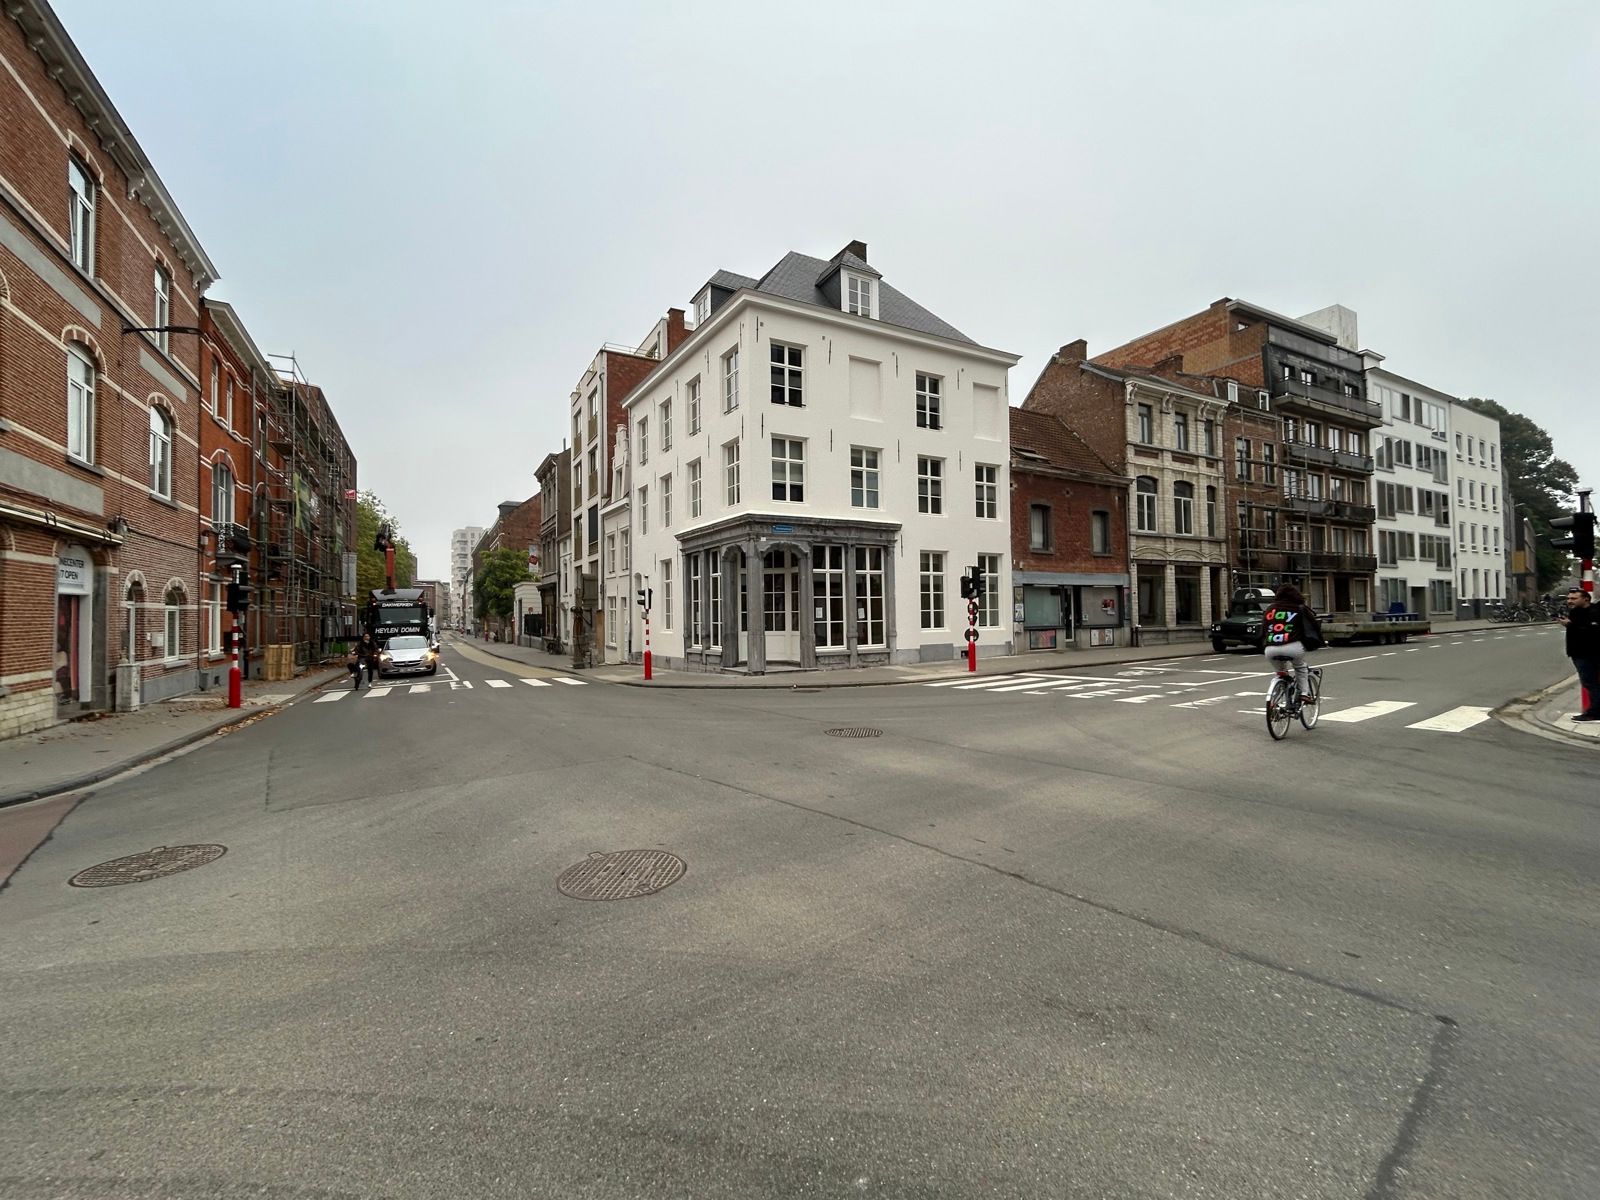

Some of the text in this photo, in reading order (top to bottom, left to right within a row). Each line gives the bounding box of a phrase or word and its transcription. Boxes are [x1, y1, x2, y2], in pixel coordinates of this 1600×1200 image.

[65, 570, 78, 580] OPEN
[1266, 609, 1298, 622] day
[1268, 624, 1293, 632] soc
[1267, 633, 1289, 642] ial
